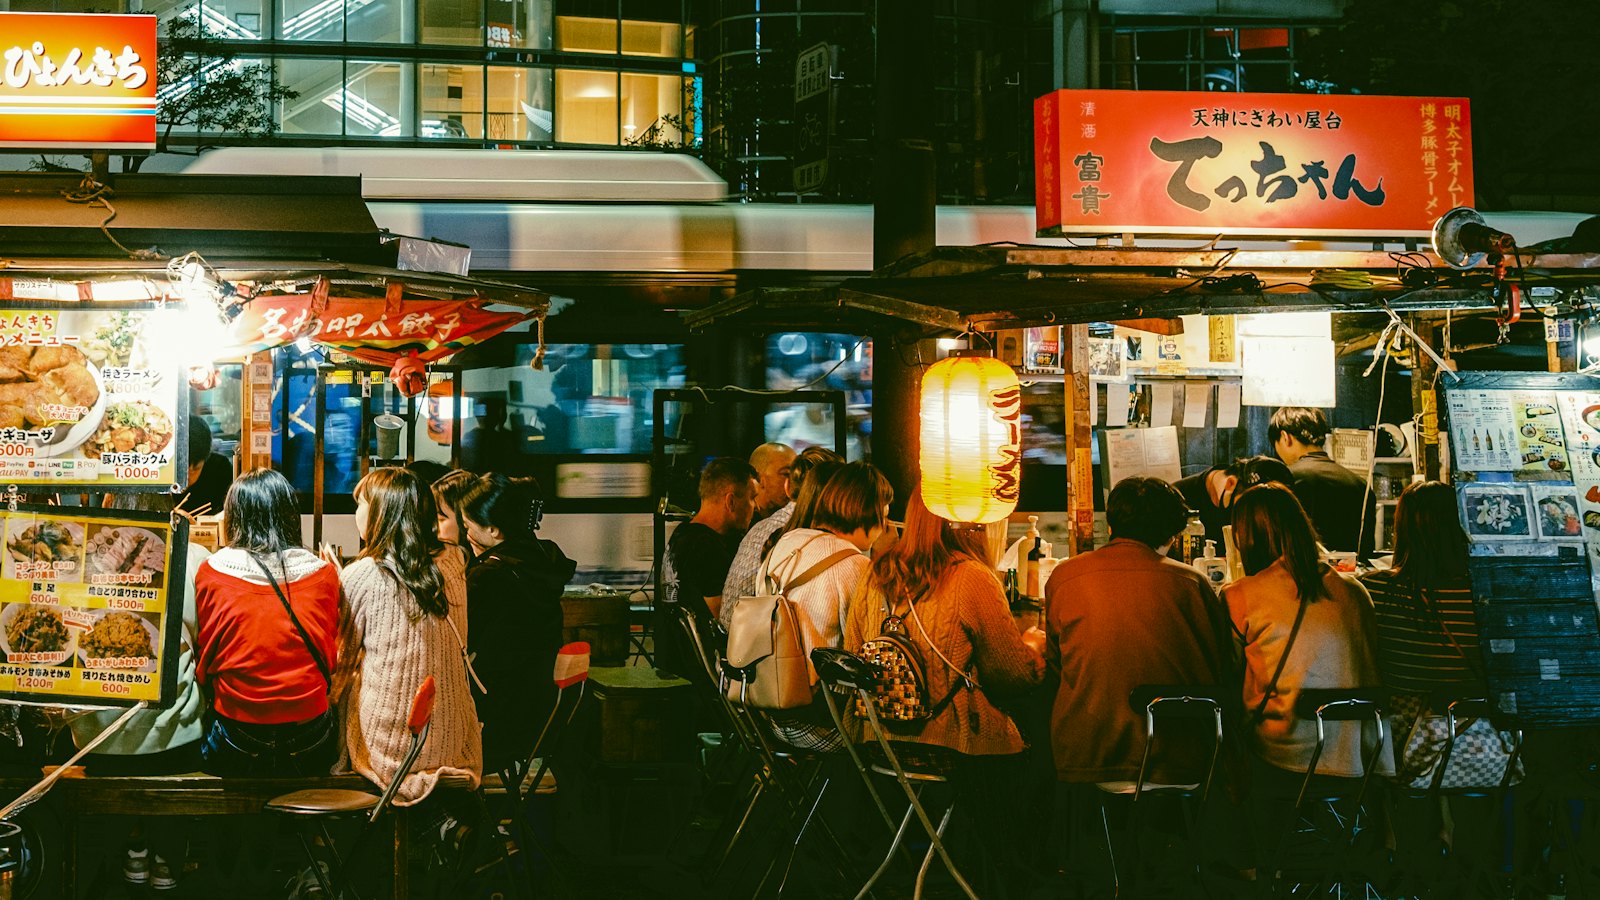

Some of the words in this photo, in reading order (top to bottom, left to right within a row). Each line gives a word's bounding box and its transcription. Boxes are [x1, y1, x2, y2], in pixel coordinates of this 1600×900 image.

[4, 41, 147, 89] ぴょんきち
[1079, 100, 1097, 140] 清酒
[1191, 107, 1343, 130] 天神にぎわい屋台
[1419, 103, 1439, 225] 博多豚骨ラーメン
[1149, 135, 1387, 212] てっちゃん
[1072, 150, 1111, 216] 富貴
[102, 368, 160, 379] 焼きラーメン
[0, 428, 53, 442] ギョーザ
[114, 467, 159, 479] 1,000円
[31, 594, 59, 604] 600円
[88, 586, 157, 599] 焼きとり盛り合わせ!
[108, 599, 144, 610] 1,500円
[16, 677, 54, 688] 1,200円
[82, 671, 151, 684] 残りだれ焼きめし
[101, 683, 130, 694] 600円
